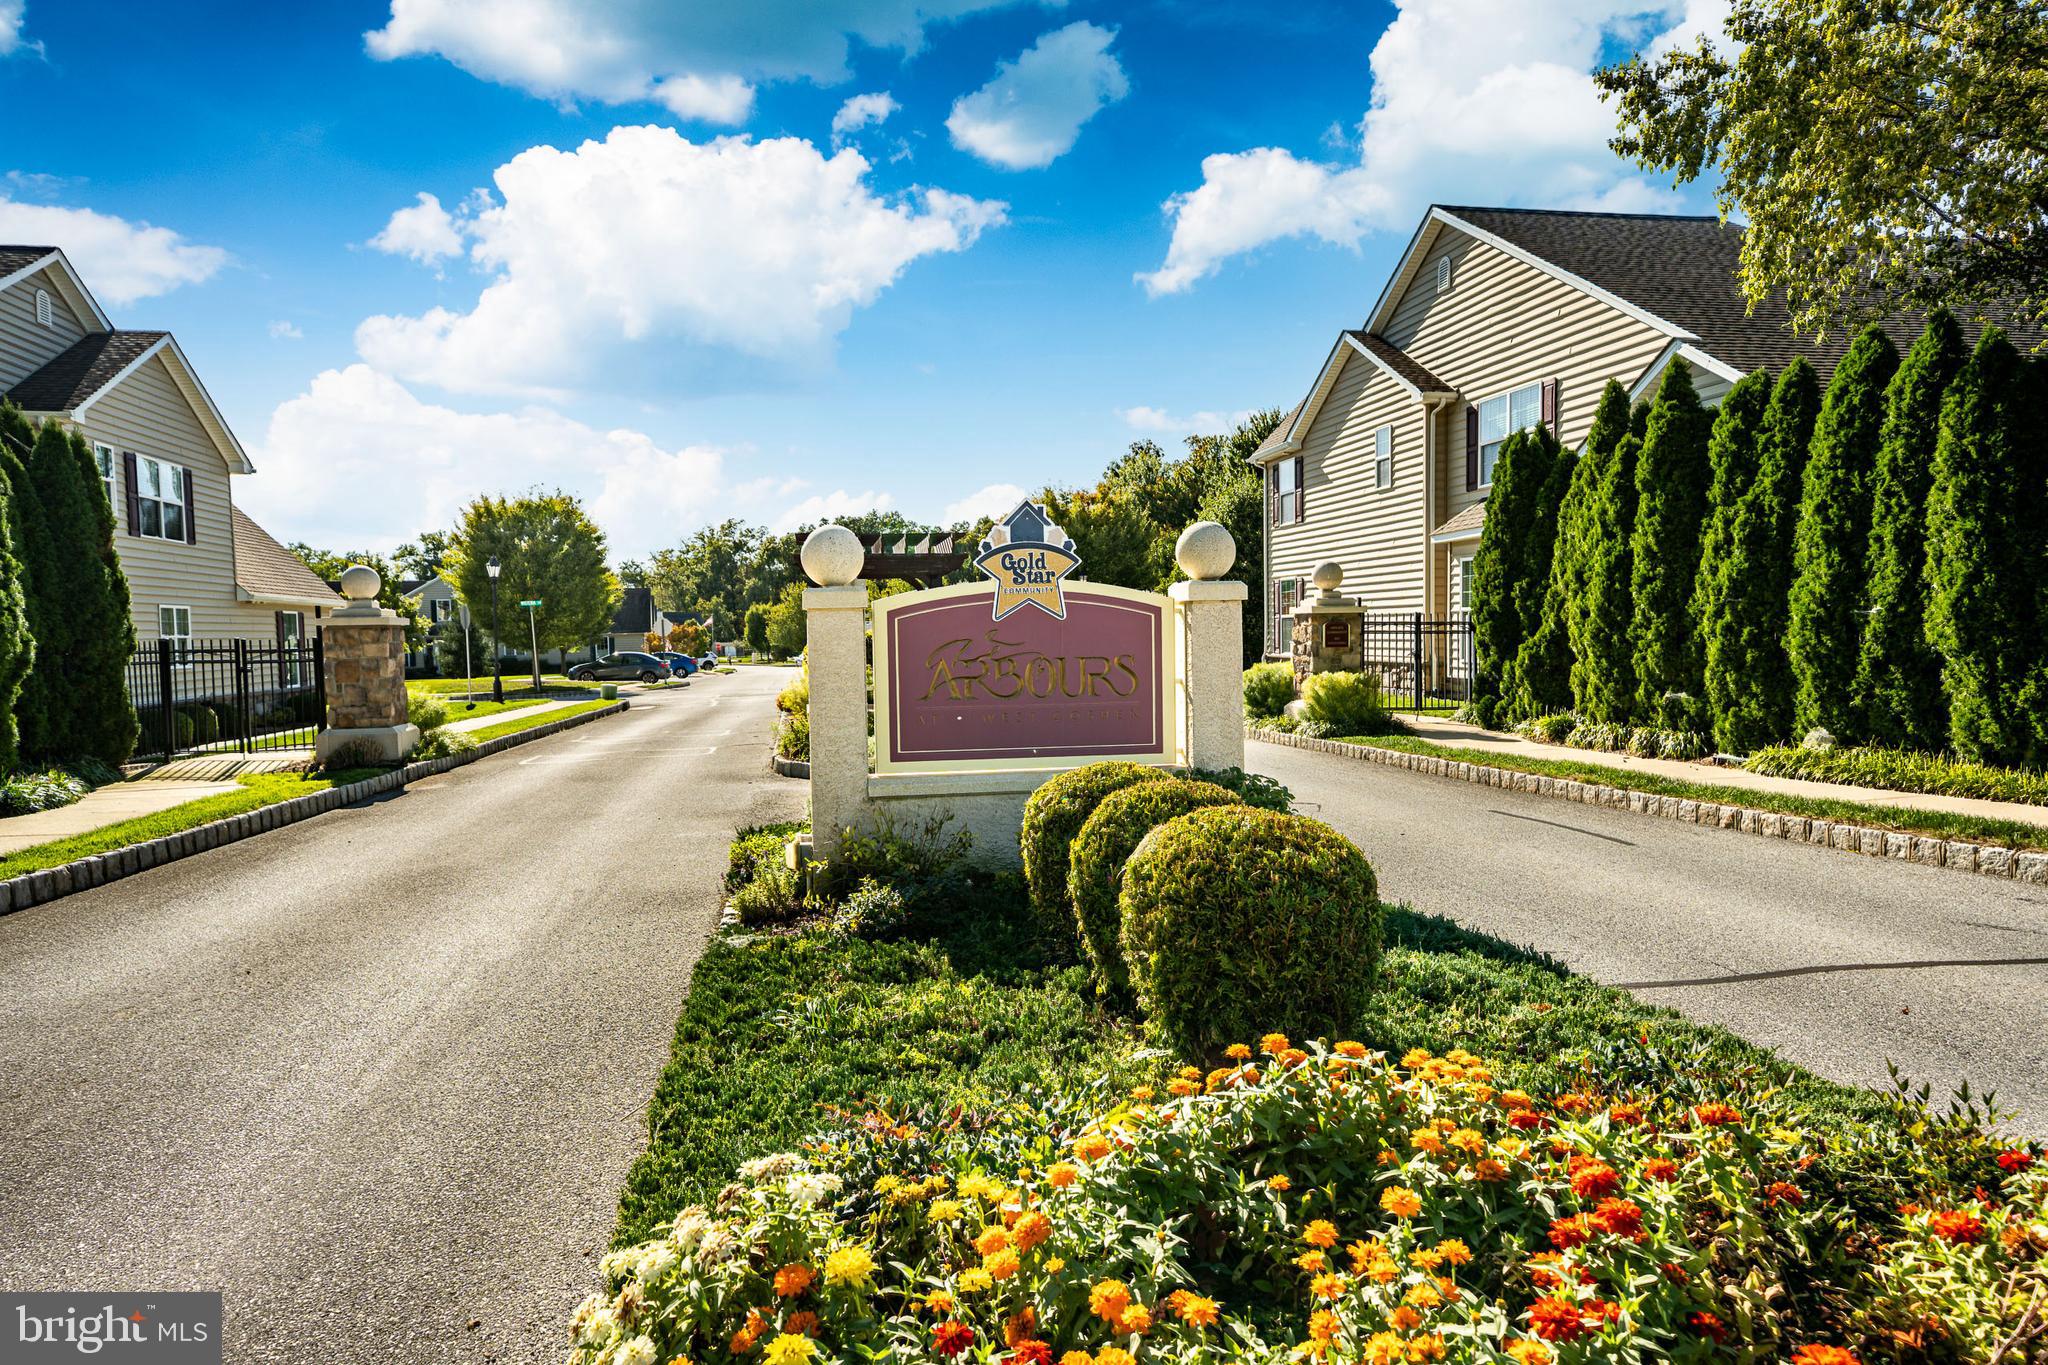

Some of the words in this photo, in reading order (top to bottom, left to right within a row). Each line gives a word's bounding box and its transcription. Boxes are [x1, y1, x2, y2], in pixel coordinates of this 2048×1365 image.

[1001, 552, 1046, 573] Gold
[1012, 570, 1055, 585] Star
[917, 648, 1139, 700] ARBOURS
